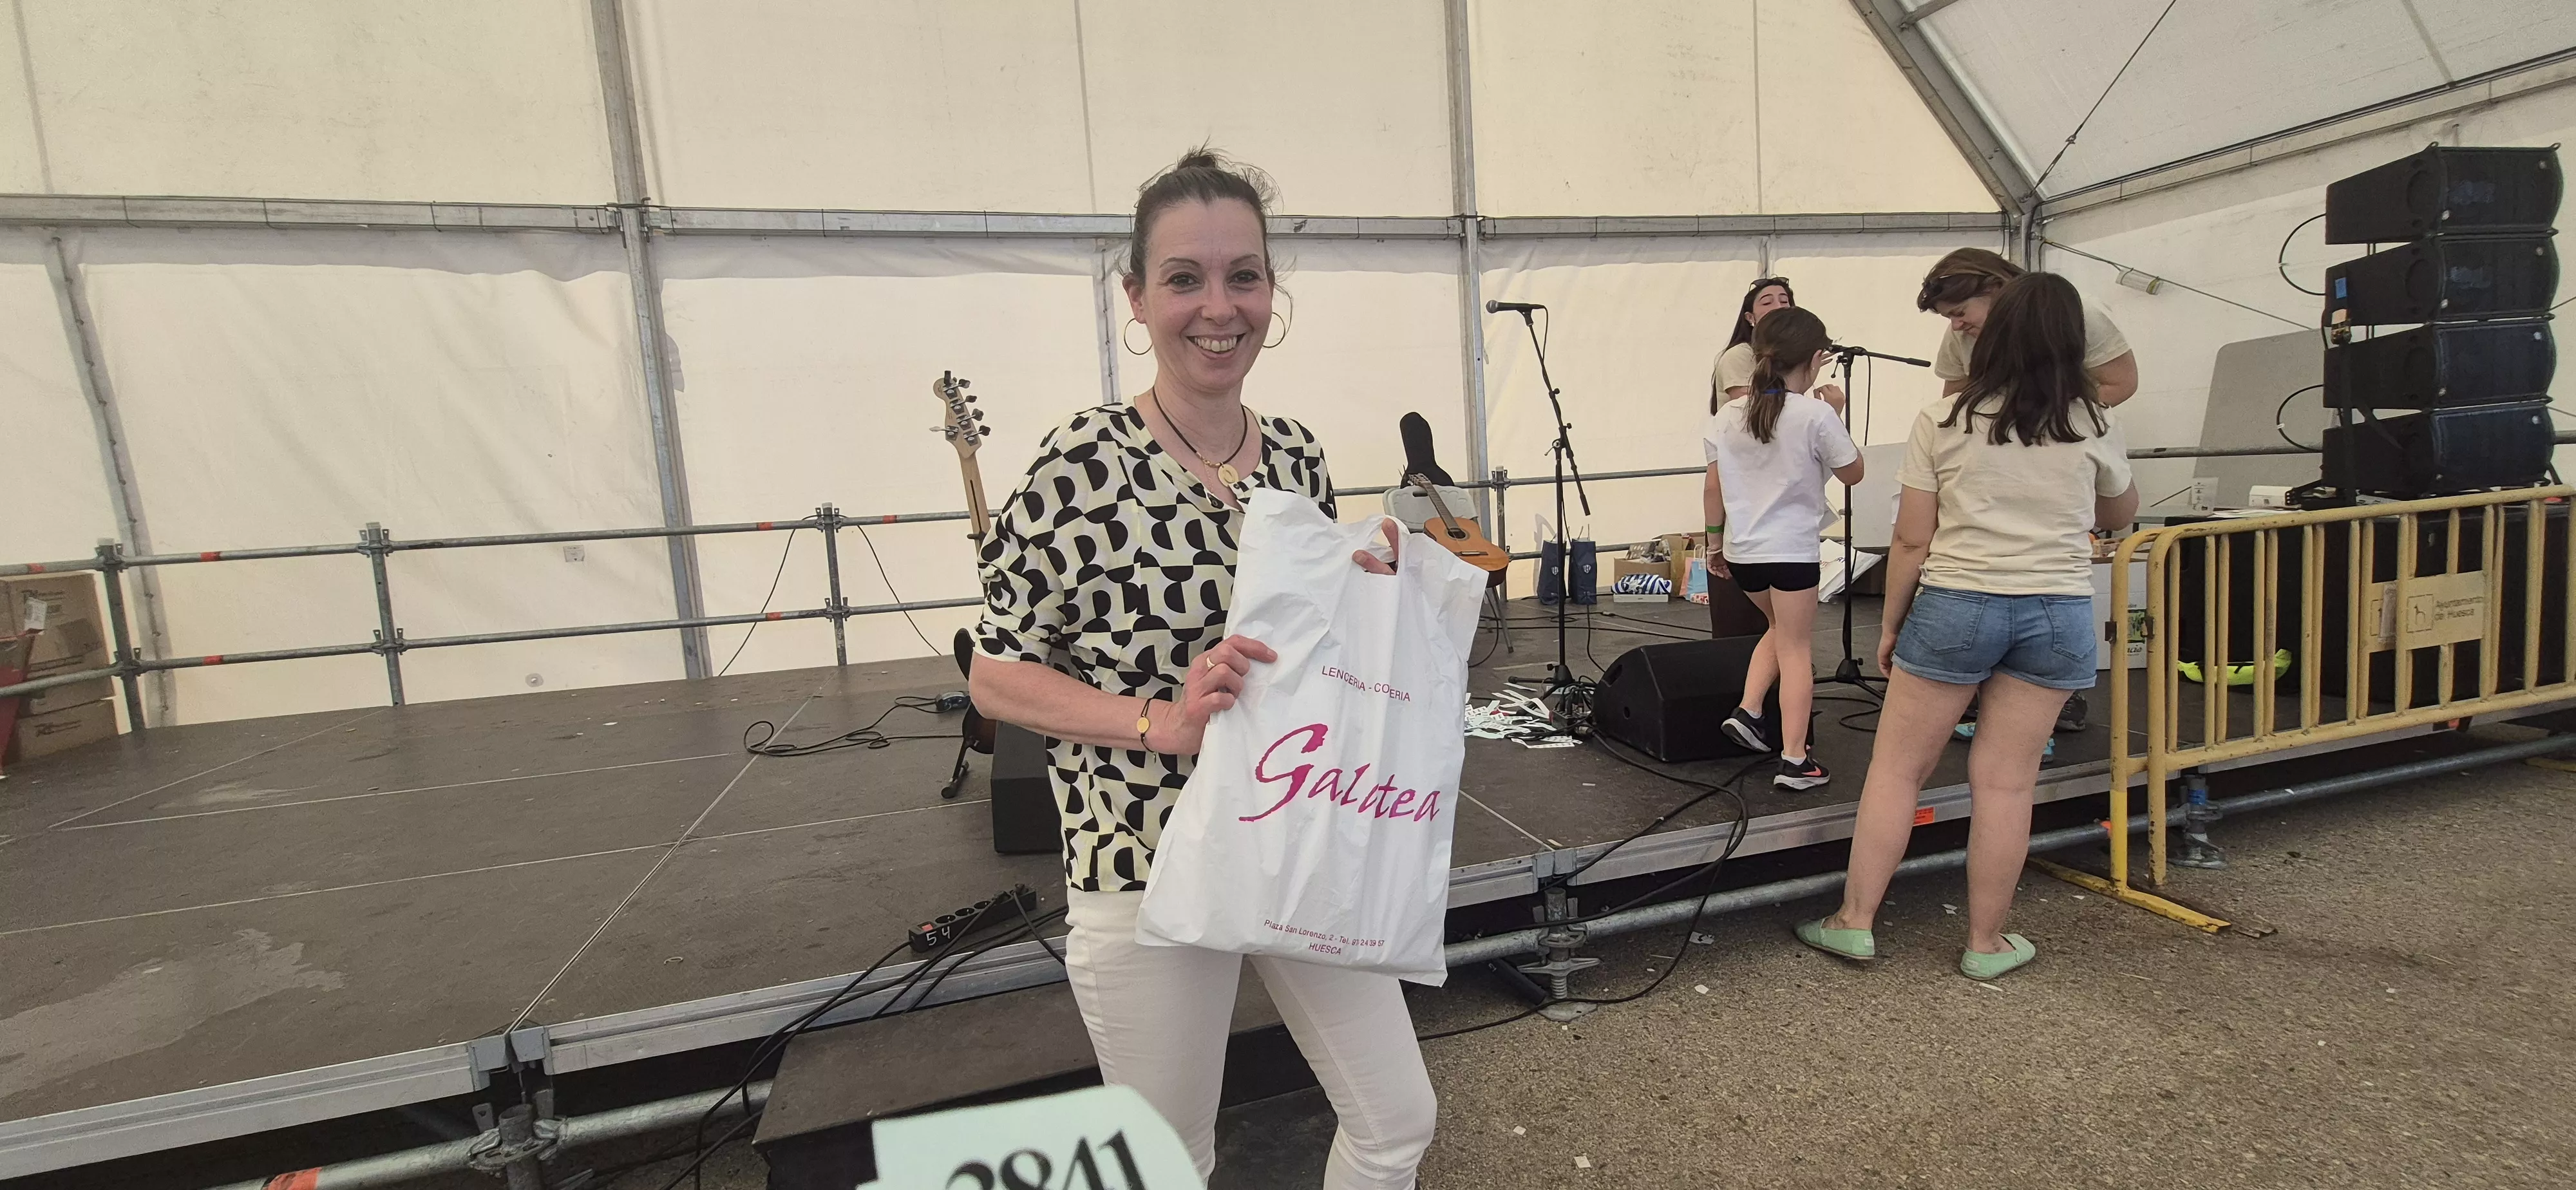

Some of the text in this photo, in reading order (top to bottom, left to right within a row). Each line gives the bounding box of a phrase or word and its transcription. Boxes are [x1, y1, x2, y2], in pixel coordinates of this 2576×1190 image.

[1321, 665, 1365, 691] LENCERIA
[1264, 920, 1283, 931] Plaza
[1285, 925, 1297, 933] San
[1298, 927, 1327, 941] Lorenzo,
[1340, 936, 1350, 945] Tel.
[1309, 942, 1341, 955] HUESCA
